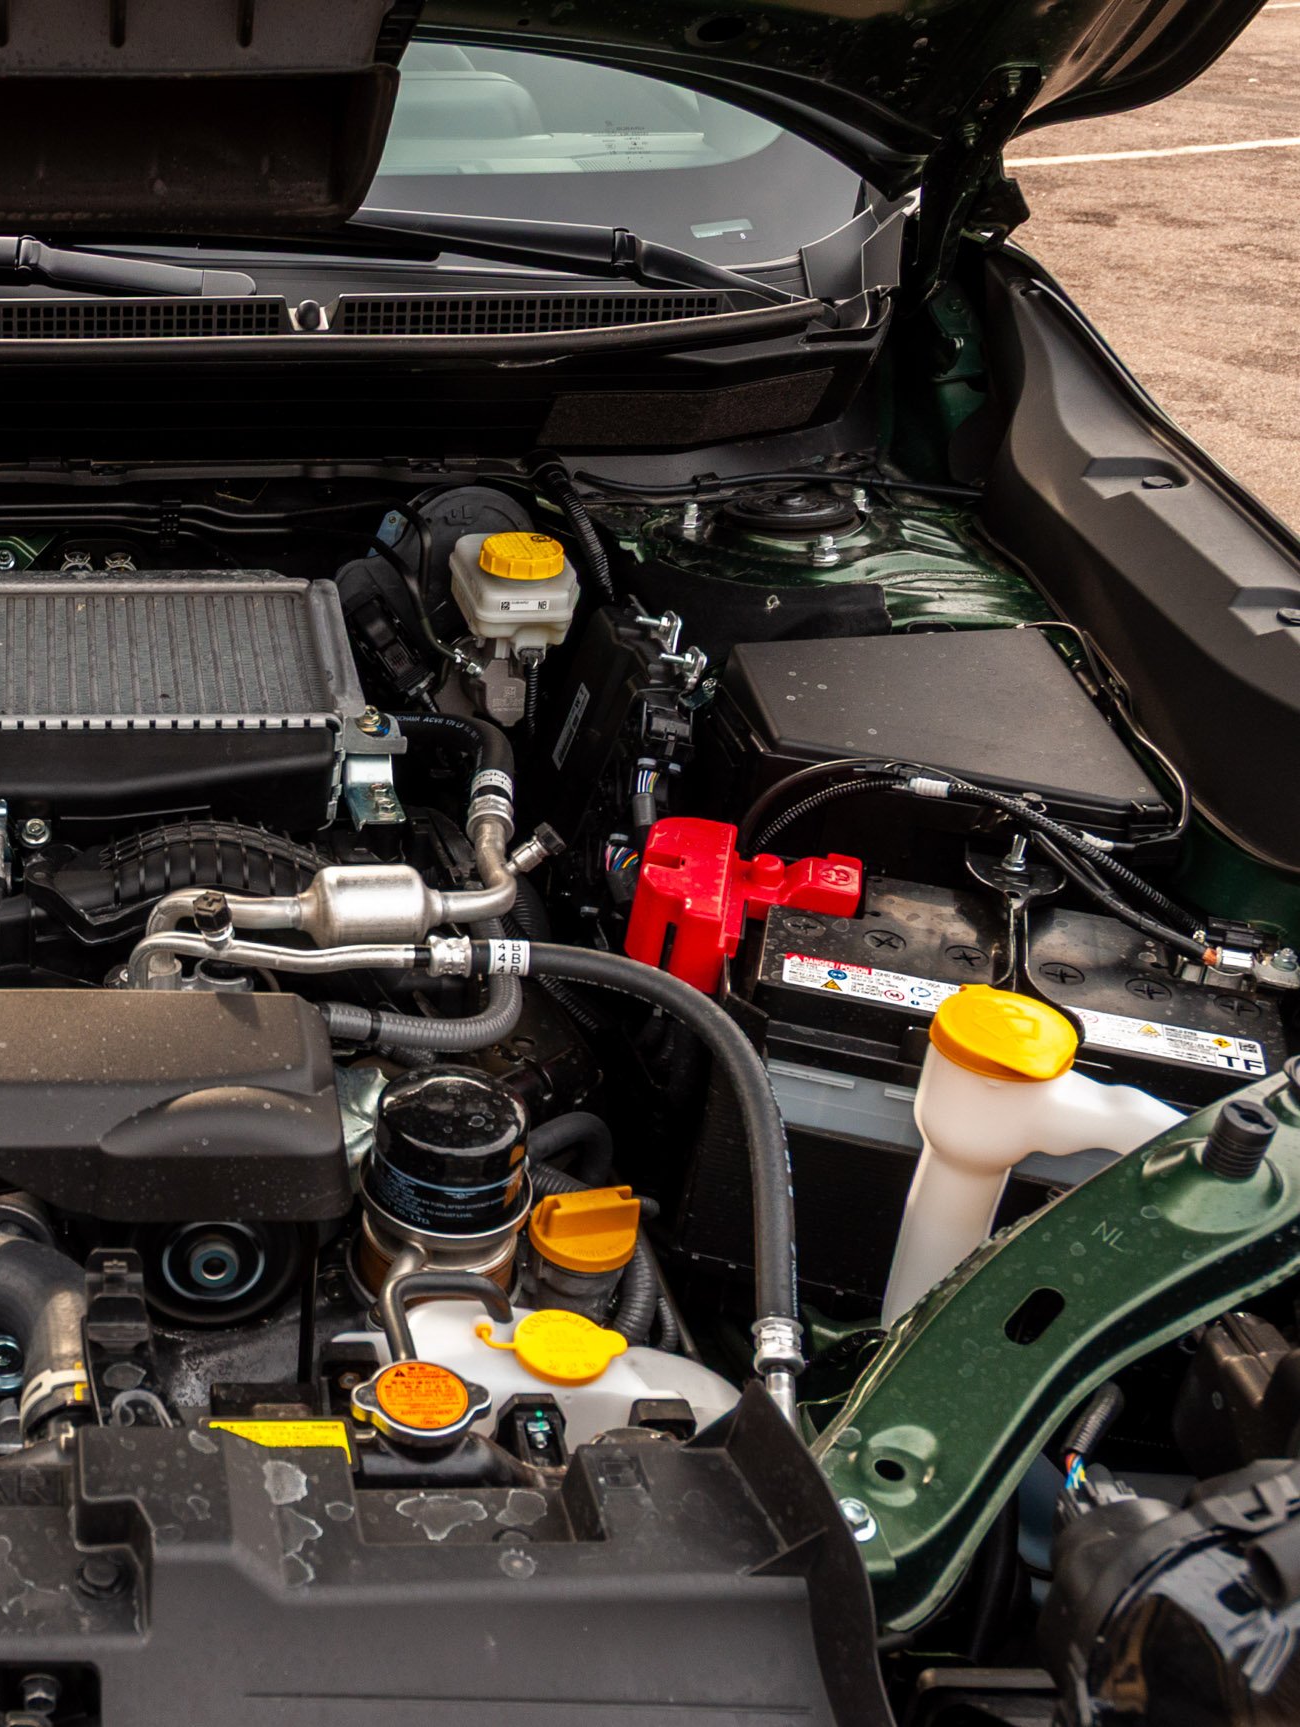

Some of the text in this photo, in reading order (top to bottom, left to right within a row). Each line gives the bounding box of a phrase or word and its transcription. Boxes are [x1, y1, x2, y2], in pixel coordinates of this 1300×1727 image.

[803, 957, 835, 969] DANGER
[839, 963, 869, 975] POISON
[1218, 1054, 1263, 1071] TF
[1091, 1219, 1124, 1253] NL
